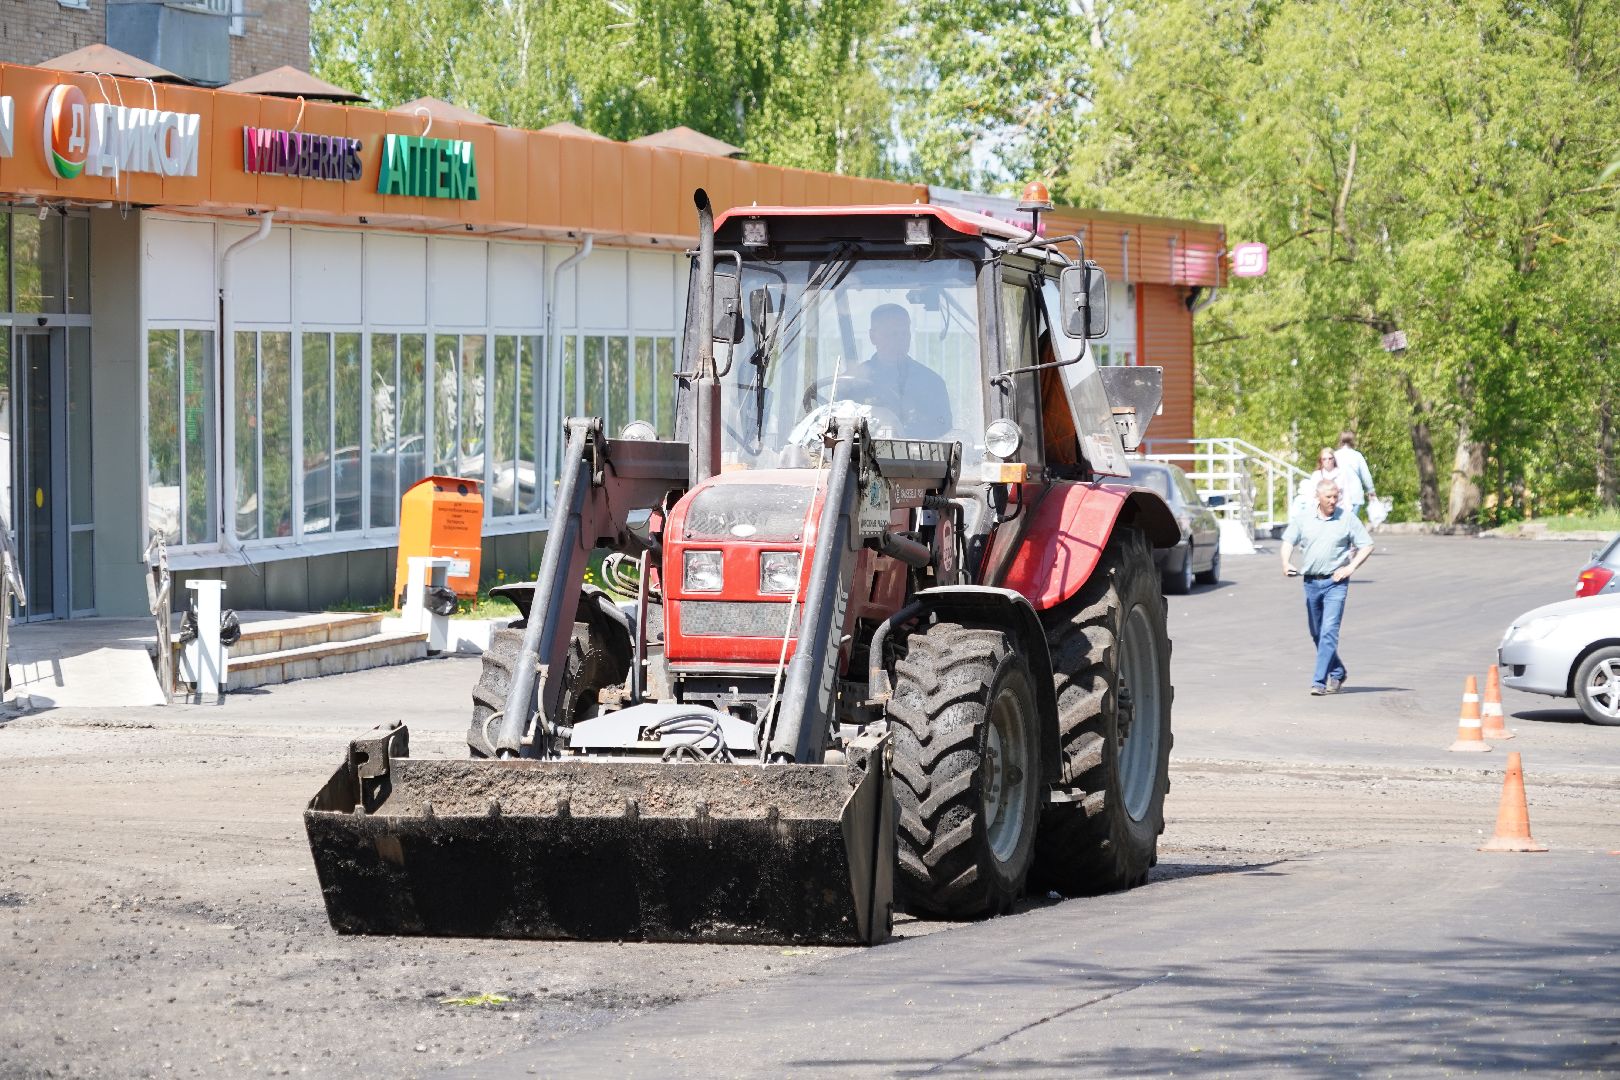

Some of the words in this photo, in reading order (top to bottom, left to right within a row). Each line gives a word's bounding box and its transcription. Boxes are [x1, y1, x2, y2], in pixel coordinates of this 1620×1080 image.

[86, 103, 200, 176] ДИКСИ
[244, 126, 363, 182] WILDBERRIES
[378, 134, 480, 201] АПТЕКА
